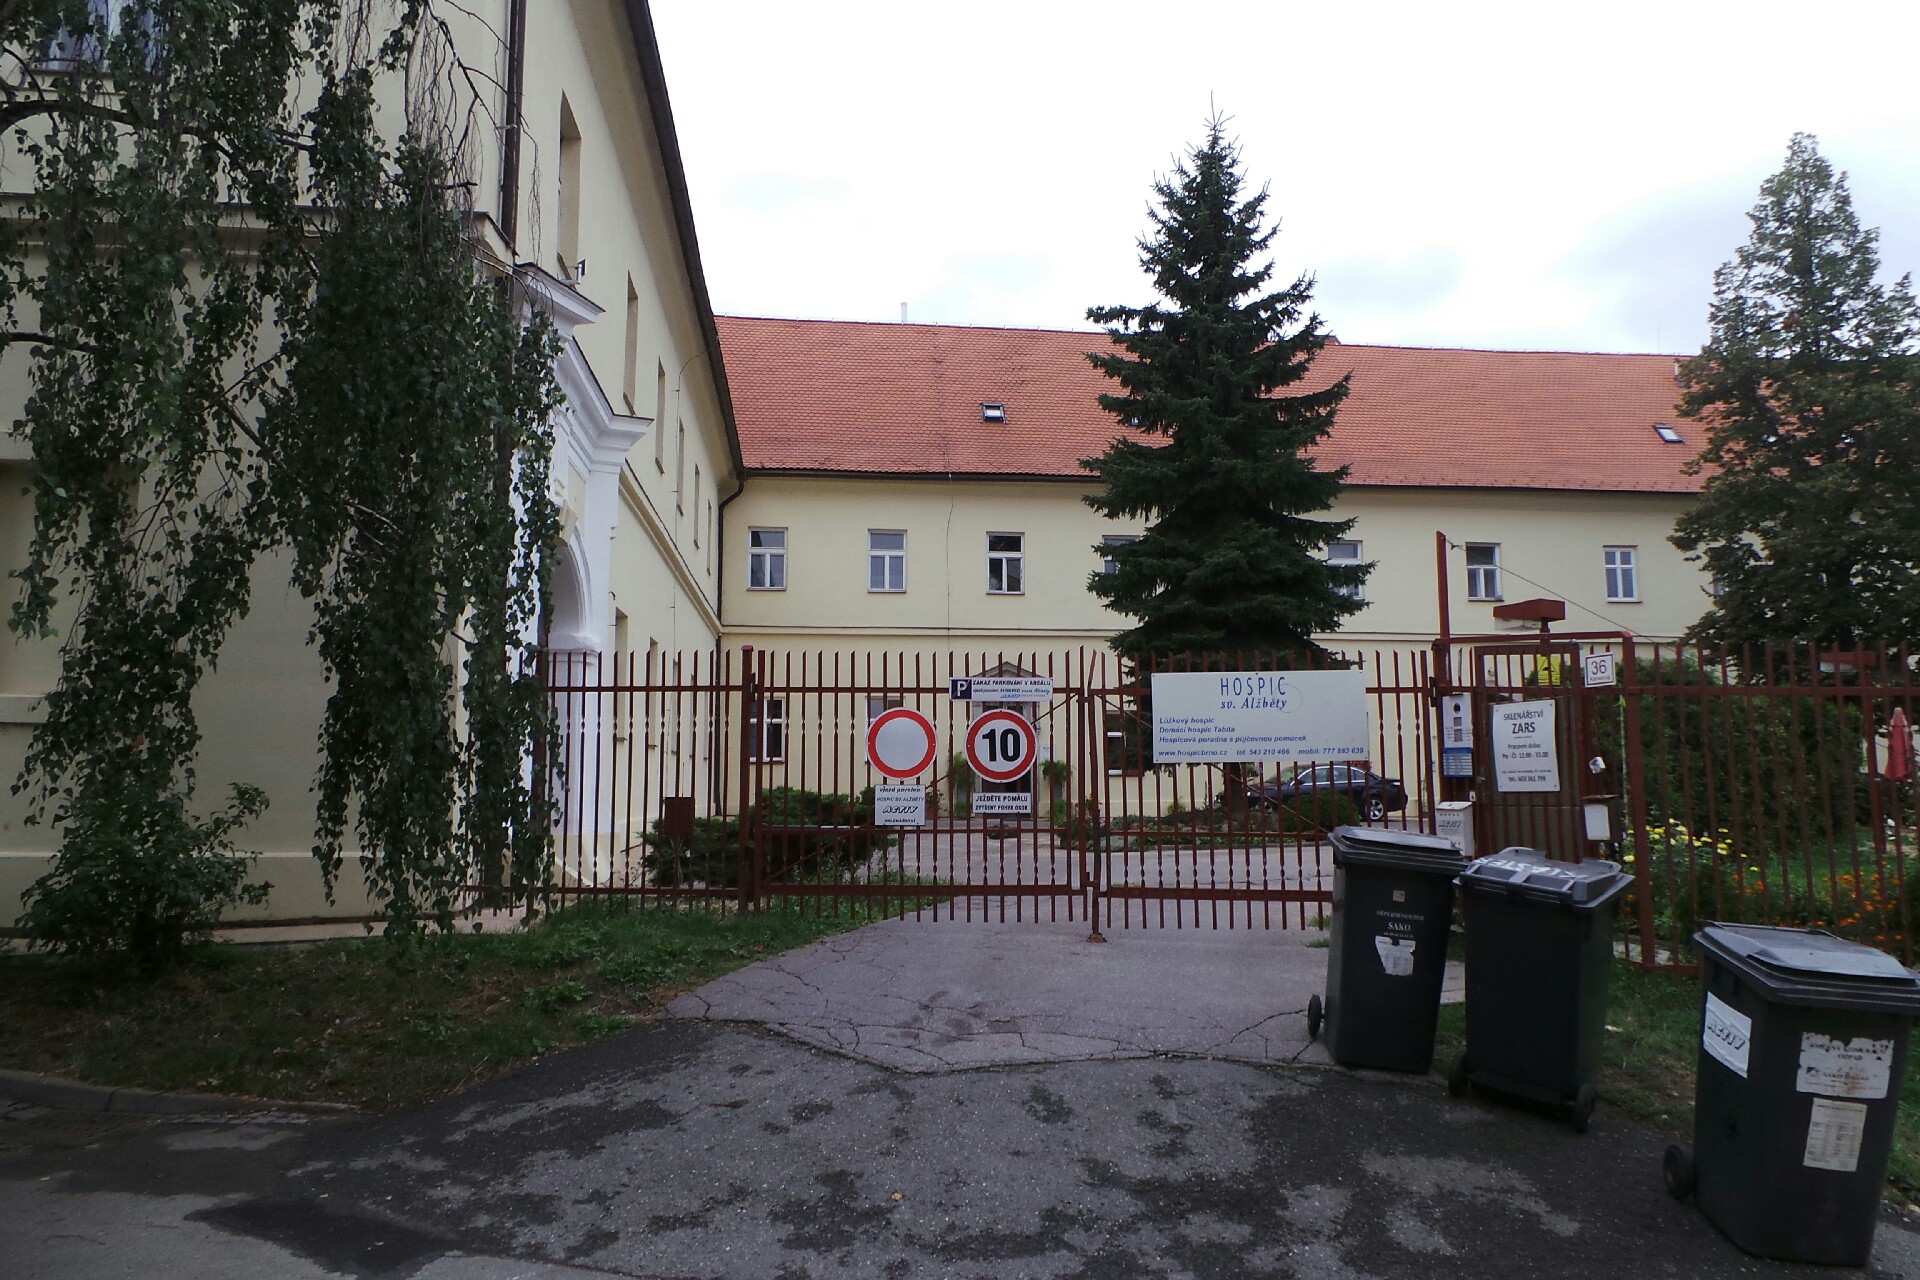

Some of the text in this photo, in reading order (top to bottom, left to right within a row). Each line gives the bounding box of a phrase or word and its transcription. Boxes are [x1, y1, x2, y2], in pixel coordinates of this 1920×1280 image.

[1591, 660, 1606, 675] 36
[1220, 676, 1286, 696] HOSPIC
[1220, 696, 1287, 710] sv. Alžběty
[1504, 709, 1544, 720] SKLENÁŘSTVÍ
[1159, 717, 1189, 725] Lůžkový
[1188, 726, 1212, 734] hospic
[1512, 722, 1535, 734] ZARS
[982, 728, 1020, 762] 10
[1198, 736, 1228, 744] poradna
[1235, 735, 1272, 744] půjčovnou
[1274, 735, 1307, 743] pomůcek
[1388, 922, 1411, 931] SAKO
